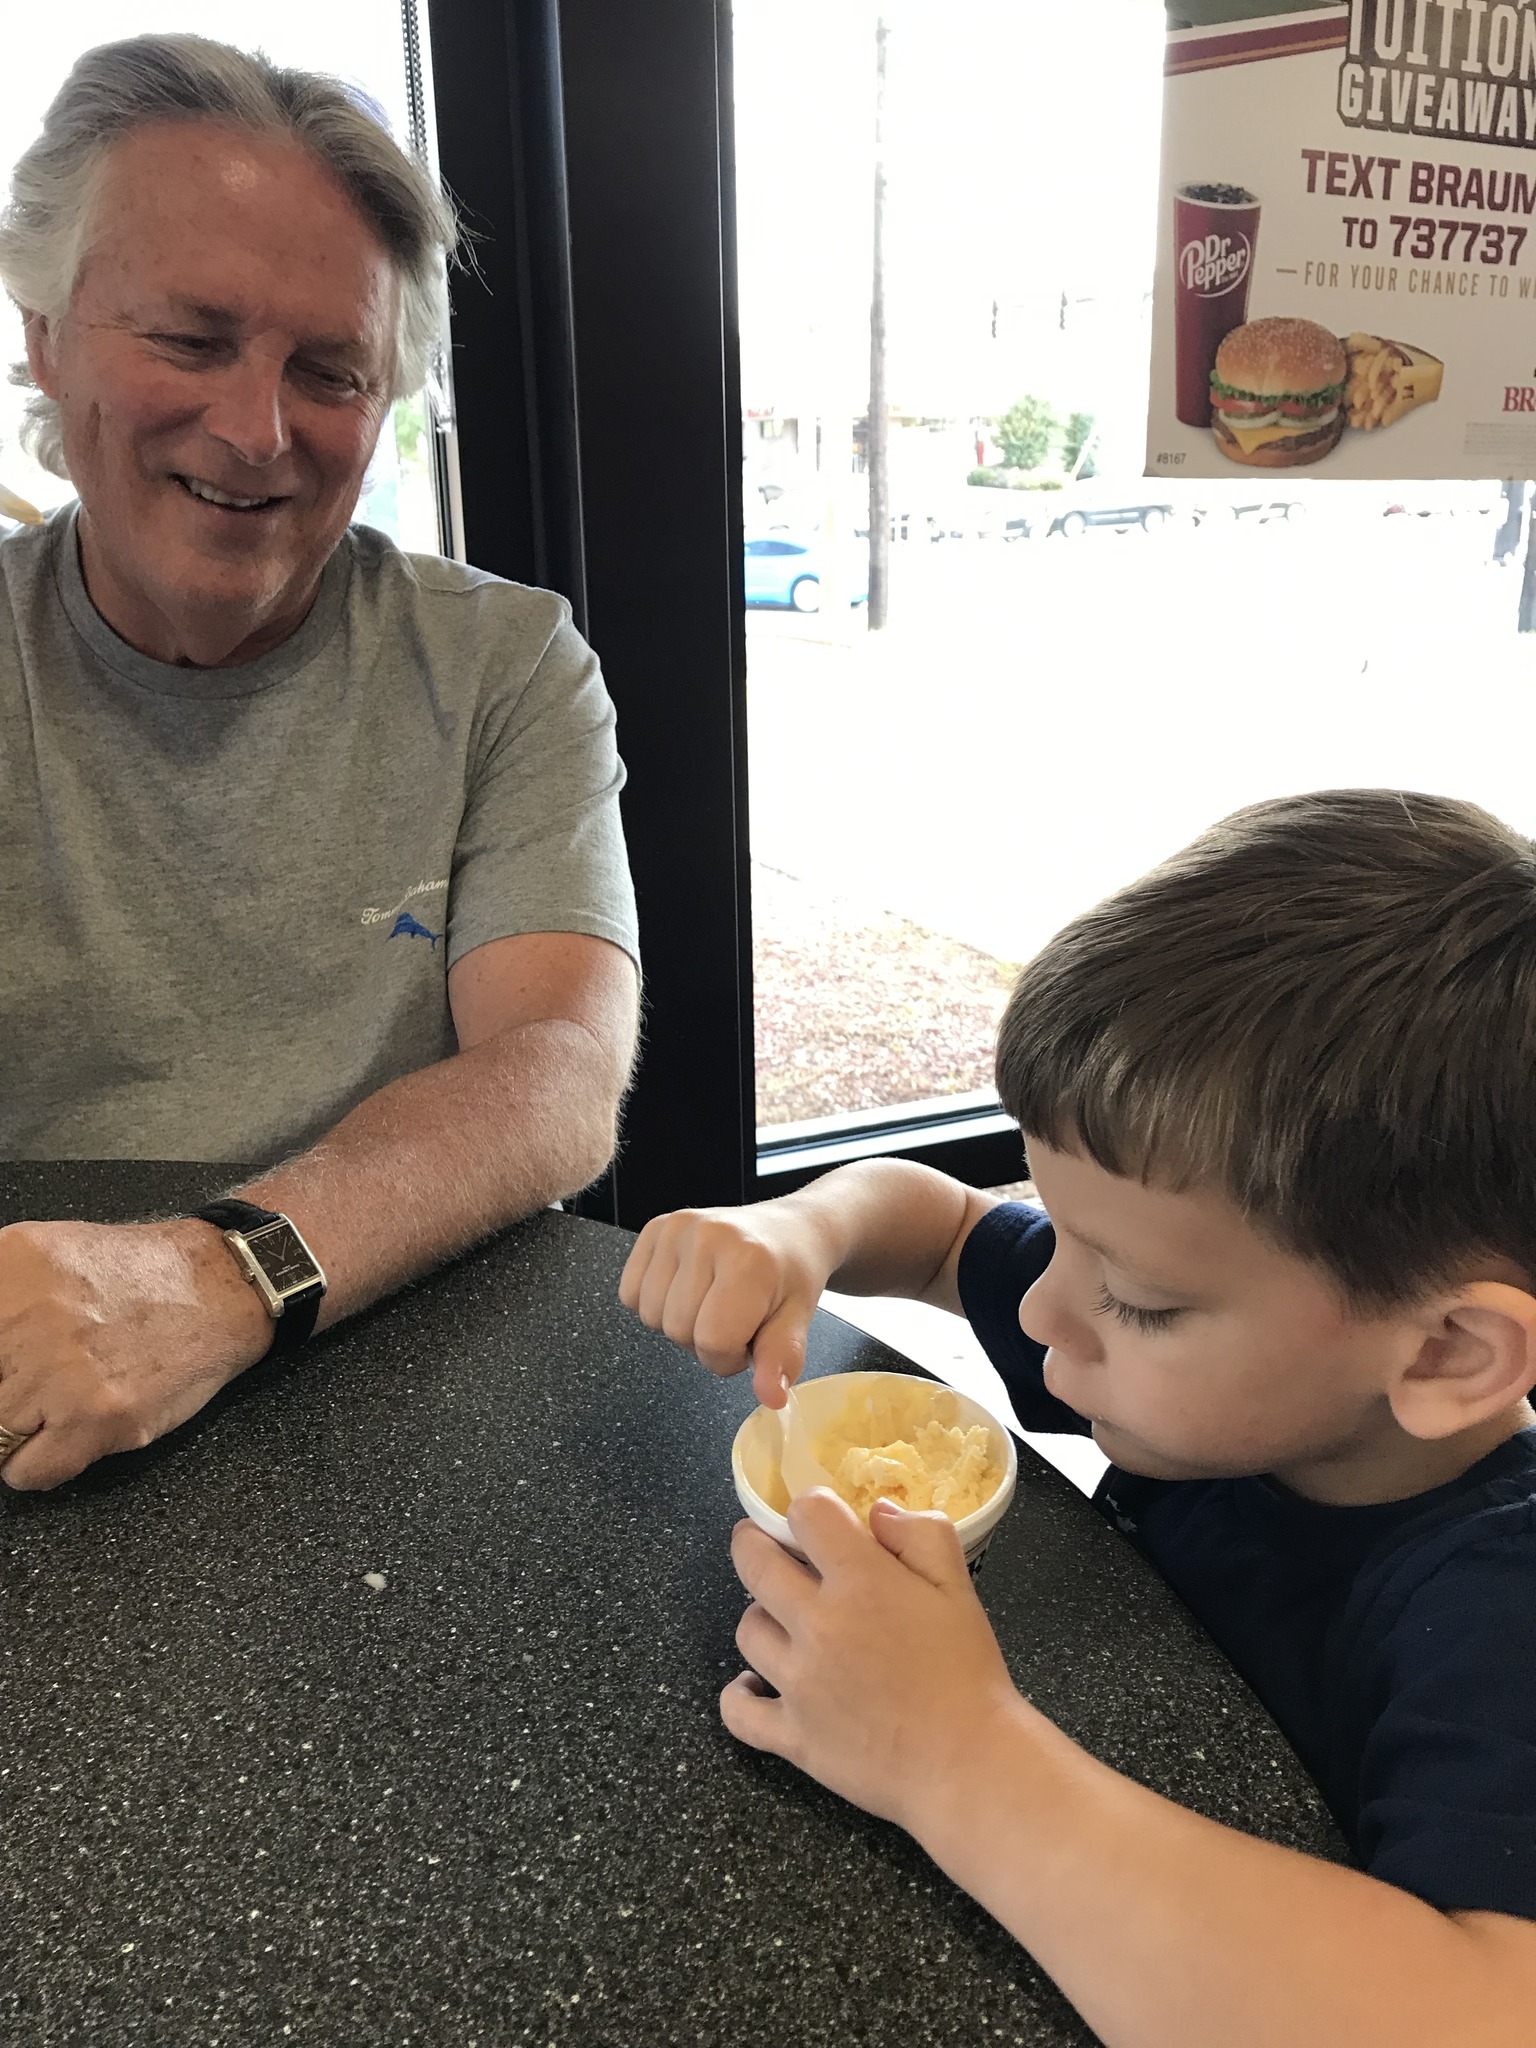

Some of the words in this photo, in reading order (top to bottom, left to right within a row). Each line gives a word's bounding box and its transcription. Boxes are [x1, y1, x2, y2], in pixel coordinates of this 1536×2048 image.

[1340, 63, 1536, 141] GIVEAWAY
[1301, 149, 1401, 201] TEXT
[1180, 240, 1246, 291] Pepper
[1205, 234, 1231, 264] Dr
[1342, 216, 1378, 249] TO
[1389, 215, 1528, 266] 737737
[1304, 261, 1340, 288] FOR
[1351, 264, 1398, 292] YOUR
[1408, 268, 1480, 297] CHANCE
[1489, 274, 1509, 299] TO
[1156, 452, 1187, 465] #8167
